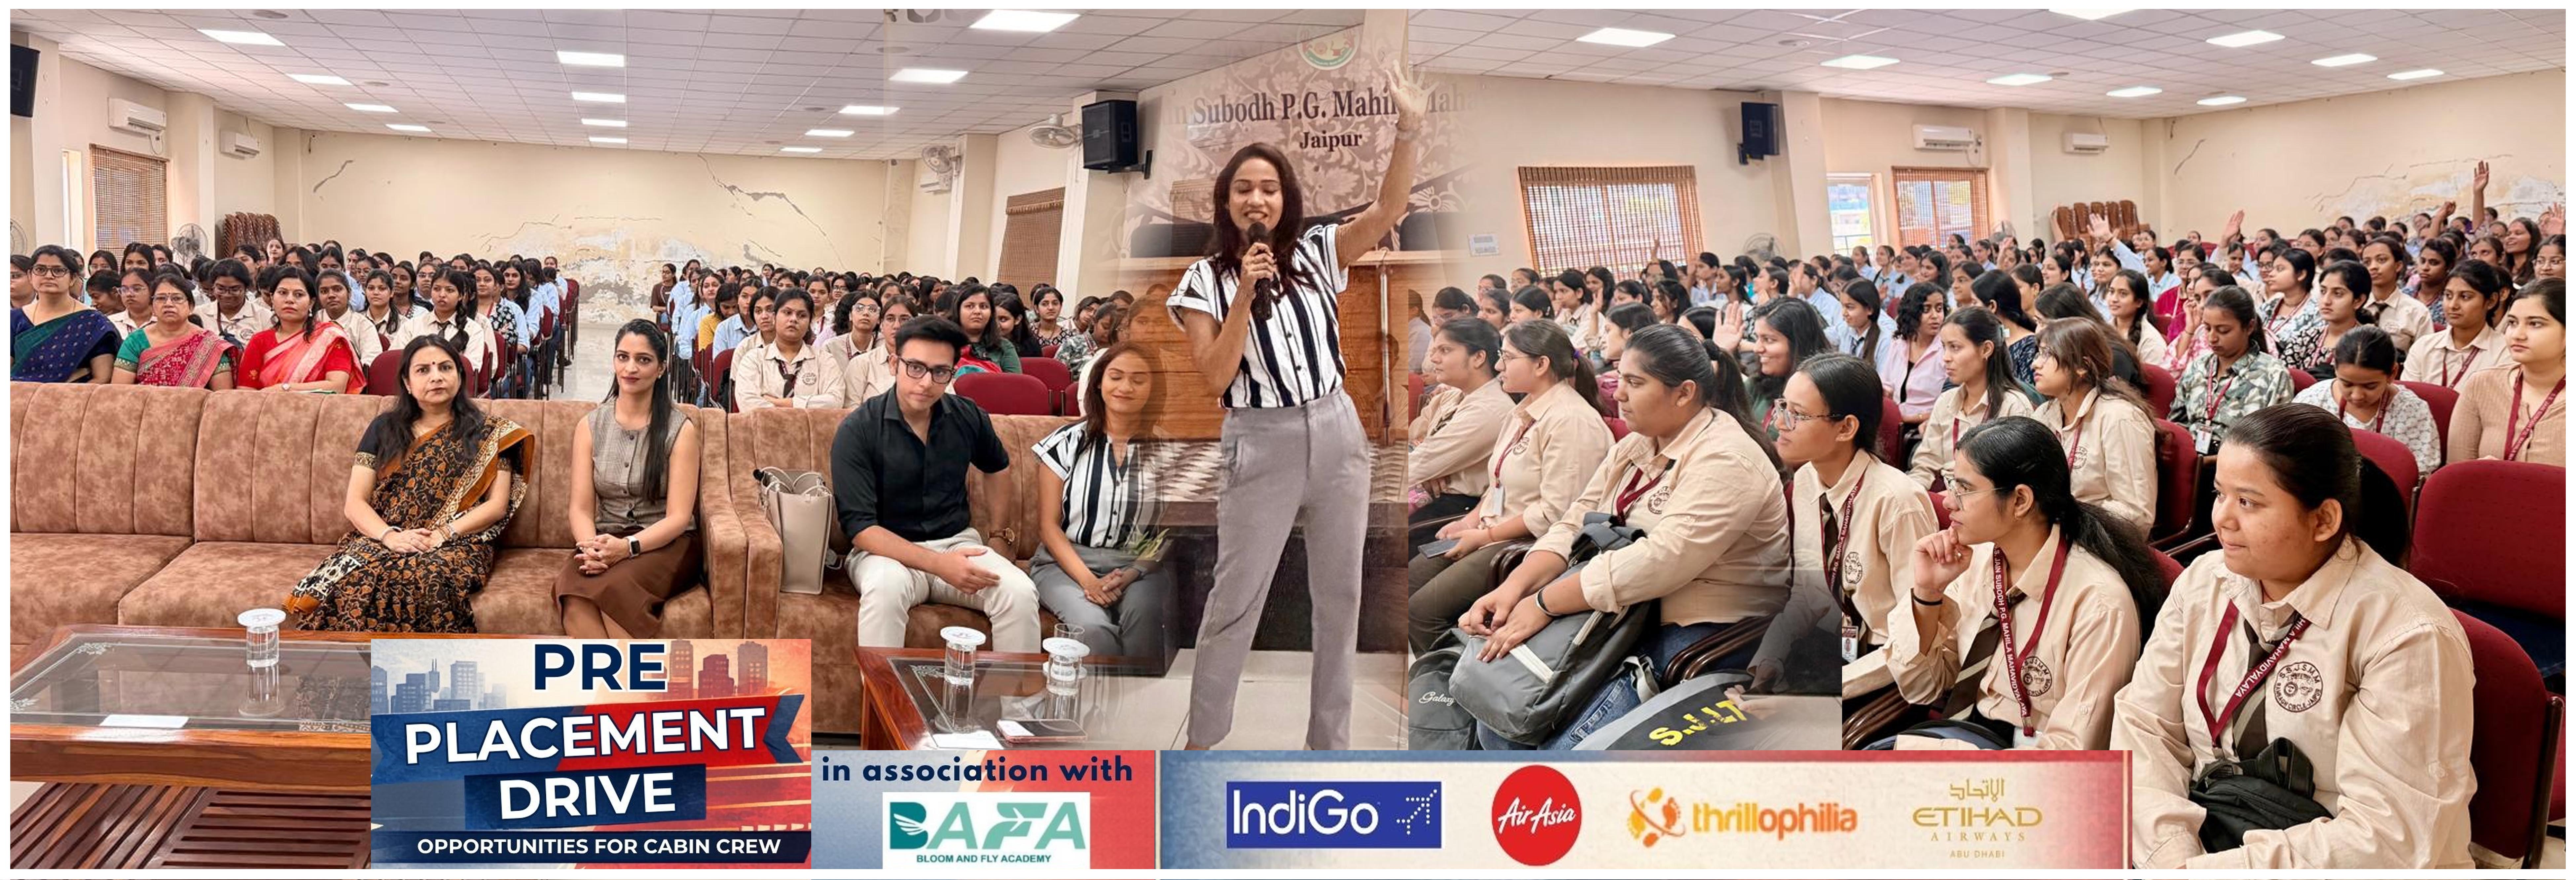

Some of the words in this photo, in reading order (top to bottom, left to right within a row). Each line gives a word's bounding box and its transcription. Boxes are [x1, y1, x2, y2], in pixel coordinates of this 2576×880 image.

[1193, 92, 1276, 124] Subodh
[1281, 91, 1326, 120] P.G.
[1299, 130, 1362, 152] Jaipur
[2289, 617, 2306, 637] HILA
[1995, 574, 2005, 606] SUBODH
[2002, 622, 2012, 653] MAHILA
[2007, 653, 2027, 717] MAHAVIDYALAYA
[2235, 636, 2291, 698] MAHAVIDYALAYA
